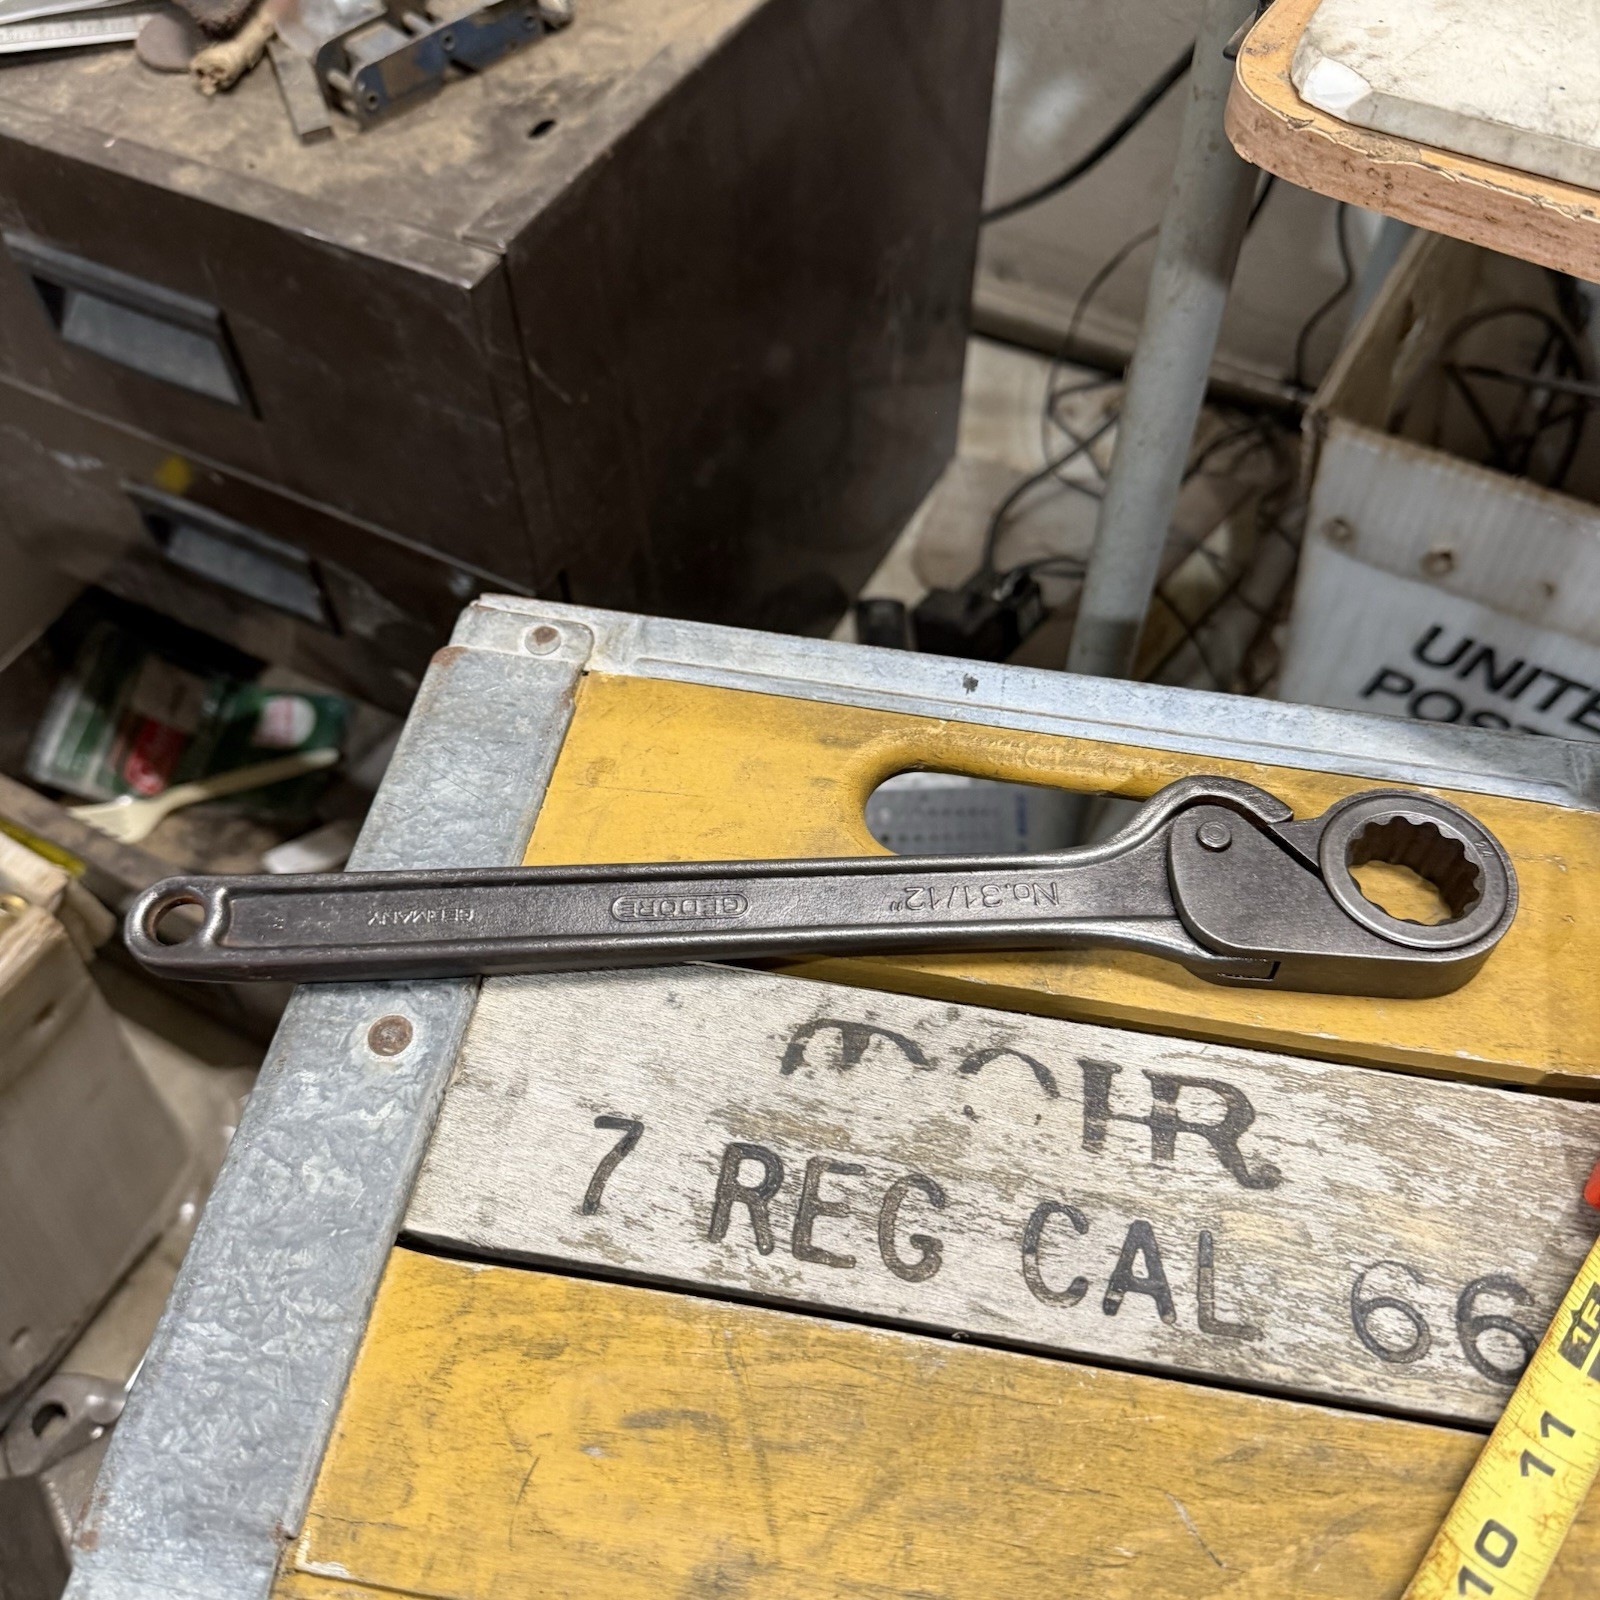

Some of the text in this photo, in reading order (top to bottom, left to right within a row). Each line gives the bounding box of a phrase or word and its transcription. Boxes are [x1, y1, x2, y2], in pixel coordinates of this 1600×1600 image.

[582, 1114, 644, 1216] 7
[707, 1142, 946, 1283] REG
[1021, 1200, 1263, 1341] CAL
[1520, 1410, 1576, 1477] 11
[1458, 1518, 1518, 1596] 10
